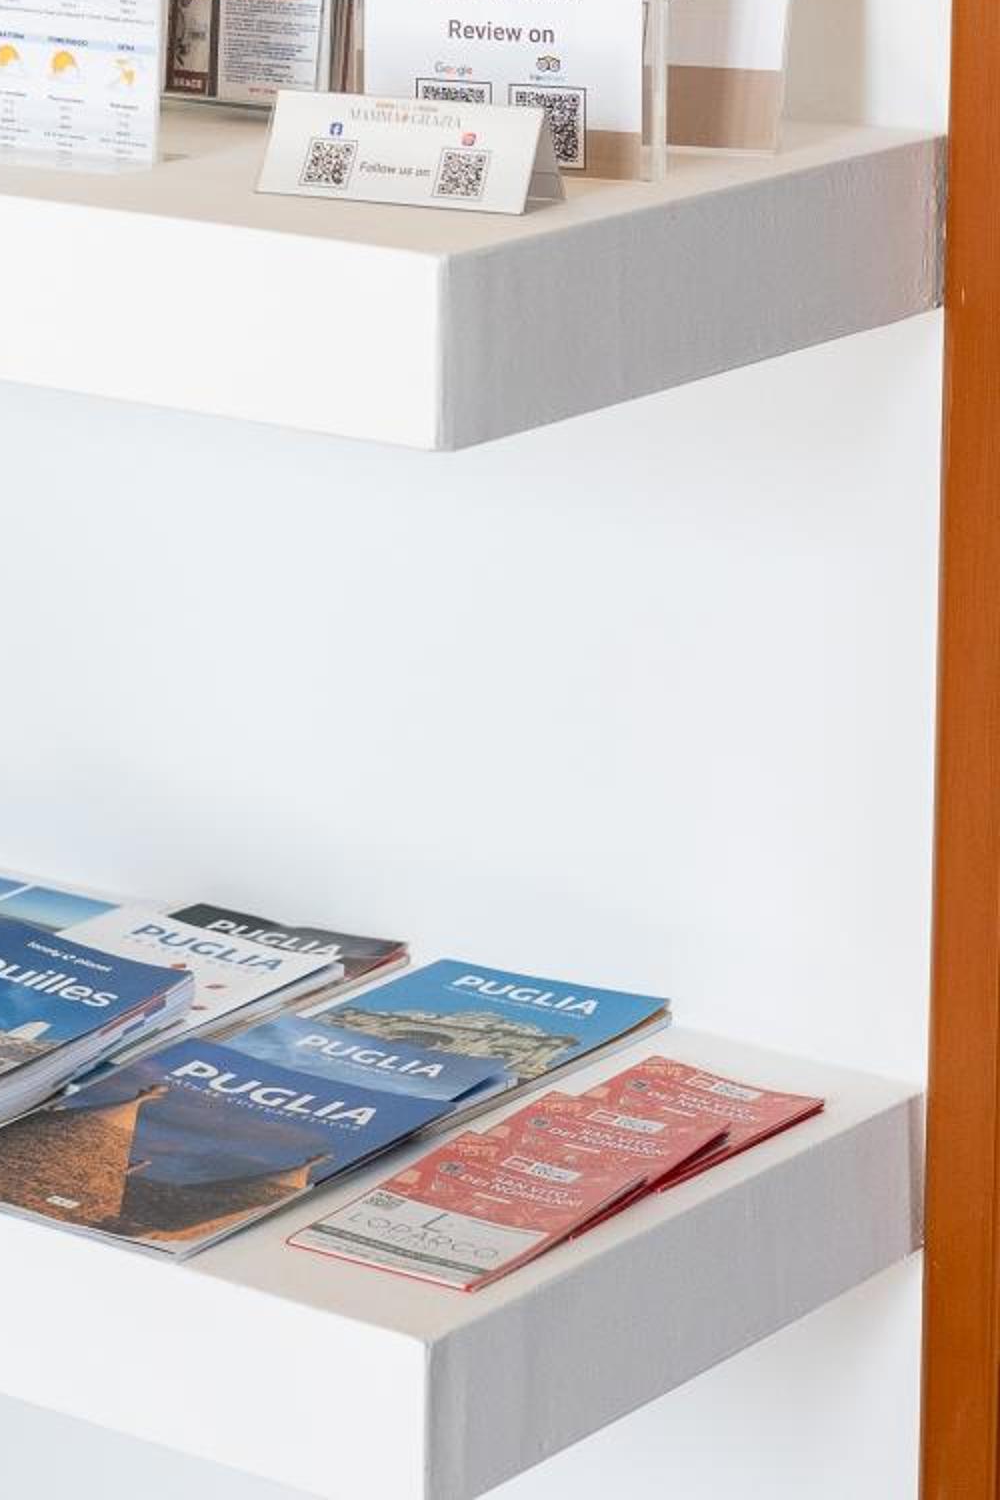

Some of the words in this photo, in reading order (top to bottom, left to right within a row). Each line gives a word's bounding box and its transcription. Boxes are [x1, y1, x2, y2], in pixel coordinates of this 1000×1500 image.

[448, 19, 522, 43] Review
[529, 26, 555, 44] on
[434, 60, 473, 79] Google
[348, 107, 401, 123] MAMMA
[410, 113, 462, 129] GRAZIA
[359, 161, 396, 174] Follow
[399, 166, 414, 176] us
[416, 168, 431, 177] on
[131, 923, 284, 972] PUGLIA
[206, 918, 344, 958] PUGLIA
[452, 975, 598, 1015] PUGLIA
[296, 1034, 443, 1078] PUGLIA
[170, 1059, 377, 1125] PUGLIA
